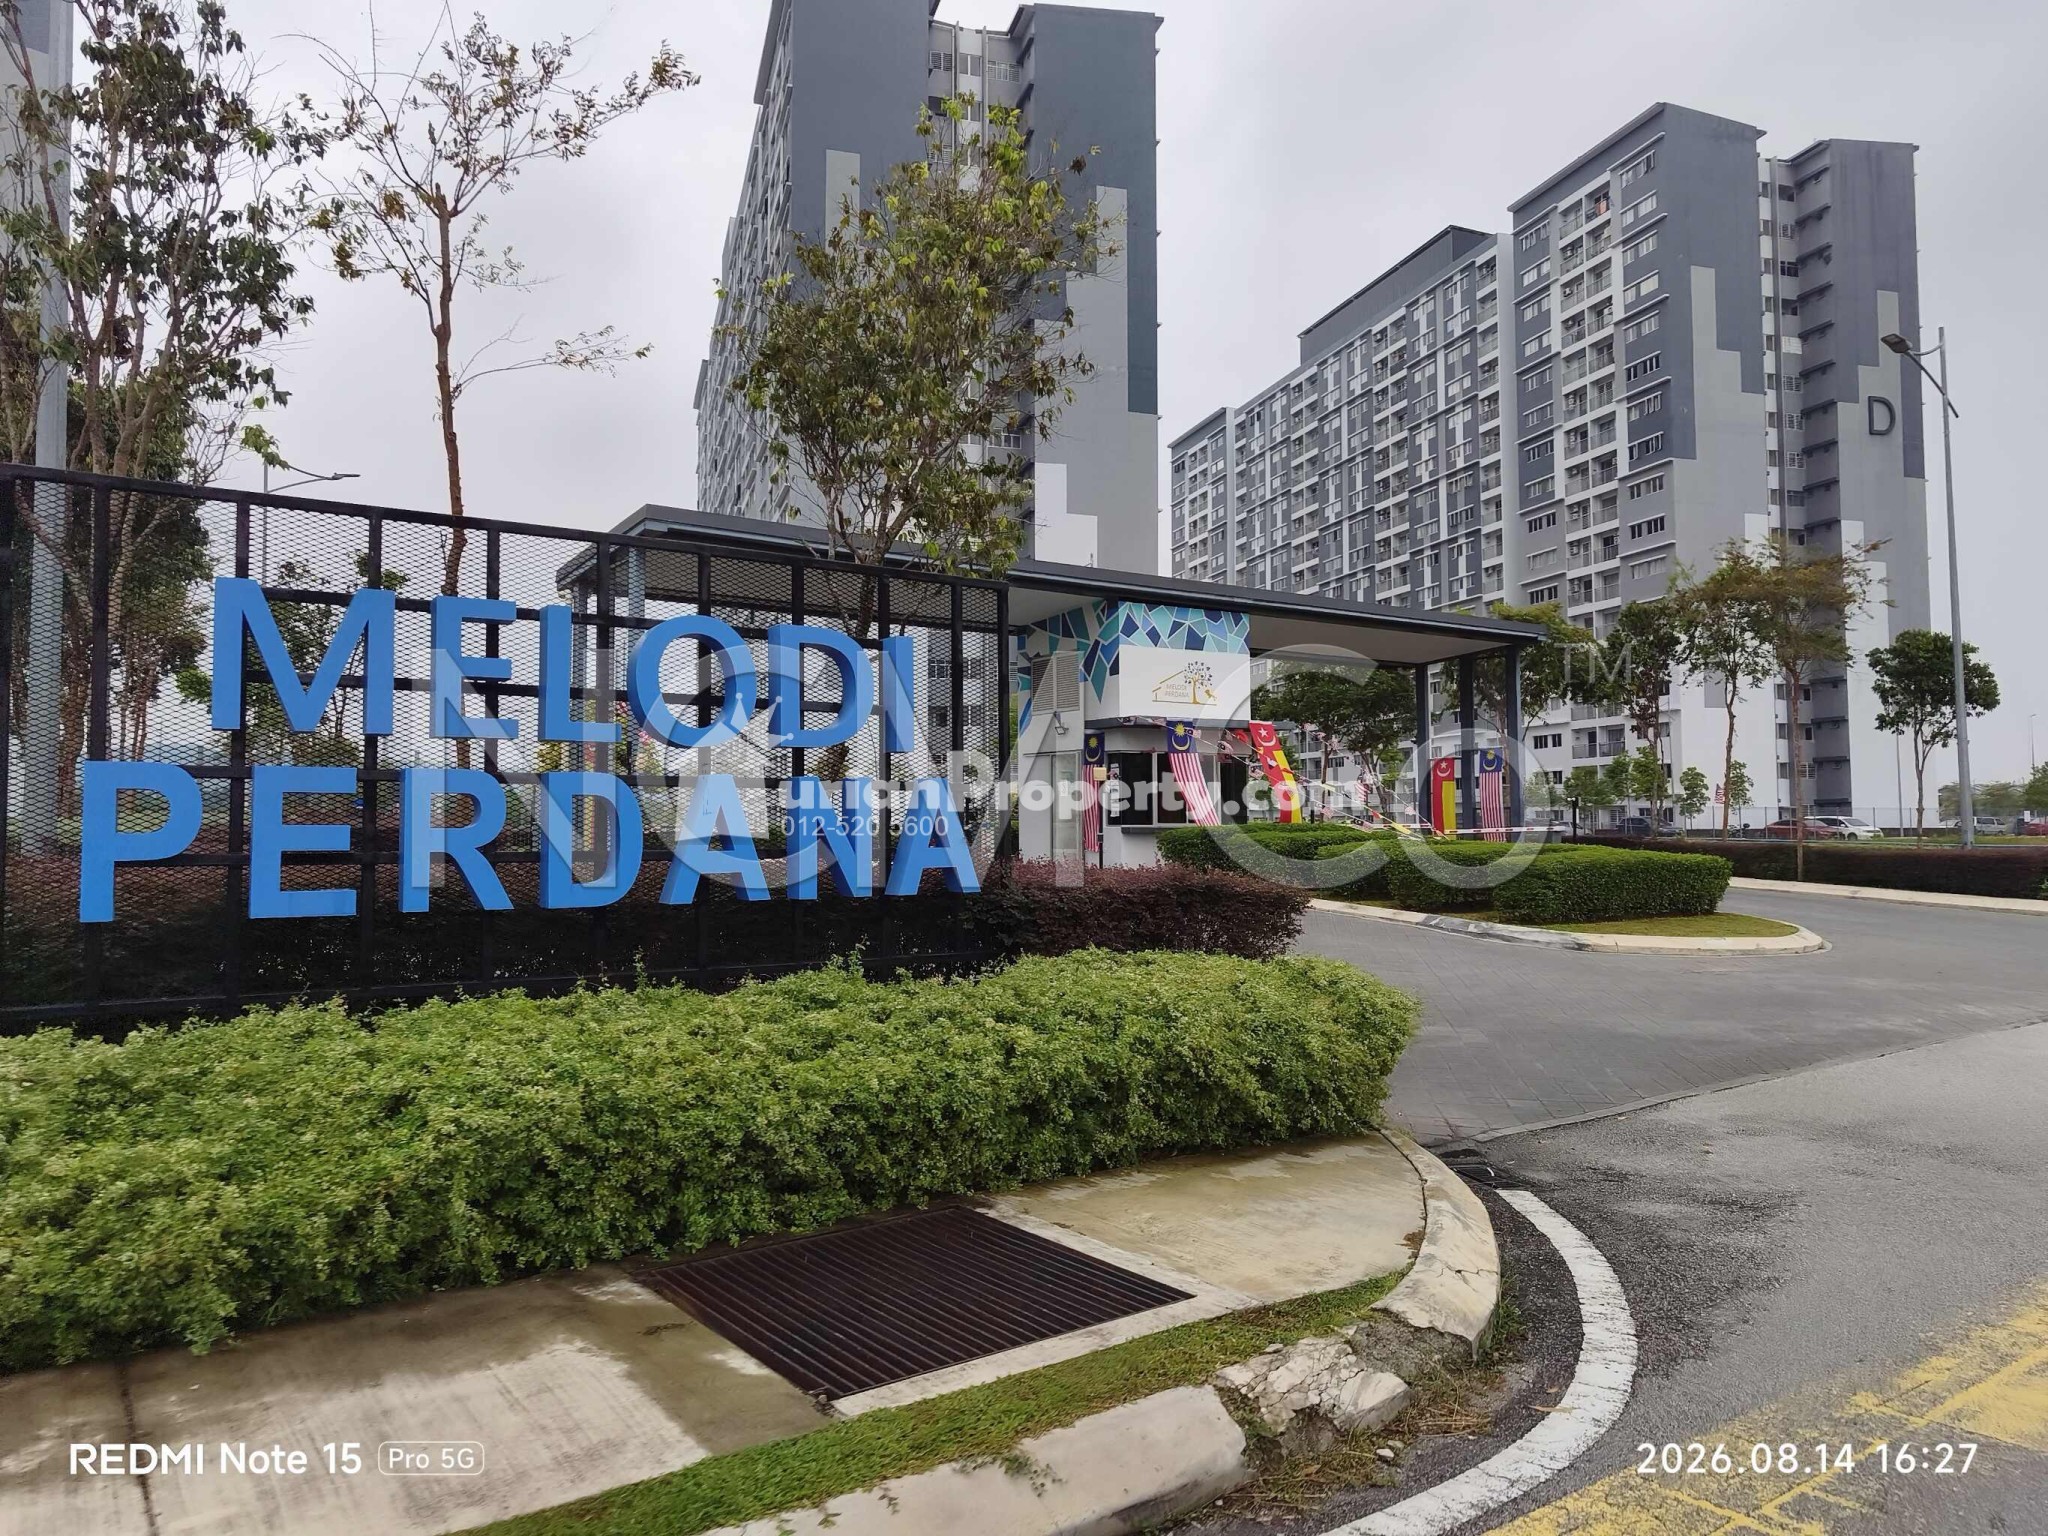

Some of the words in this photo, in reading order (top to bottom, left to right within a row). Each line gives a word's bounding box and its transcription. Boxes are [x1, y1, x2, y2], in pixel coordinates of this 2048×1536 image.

[1868, 396, 1895, 435] D
[211, 577, 915, 753] MELODI
[80, 760, 981, 923] PERDANA
